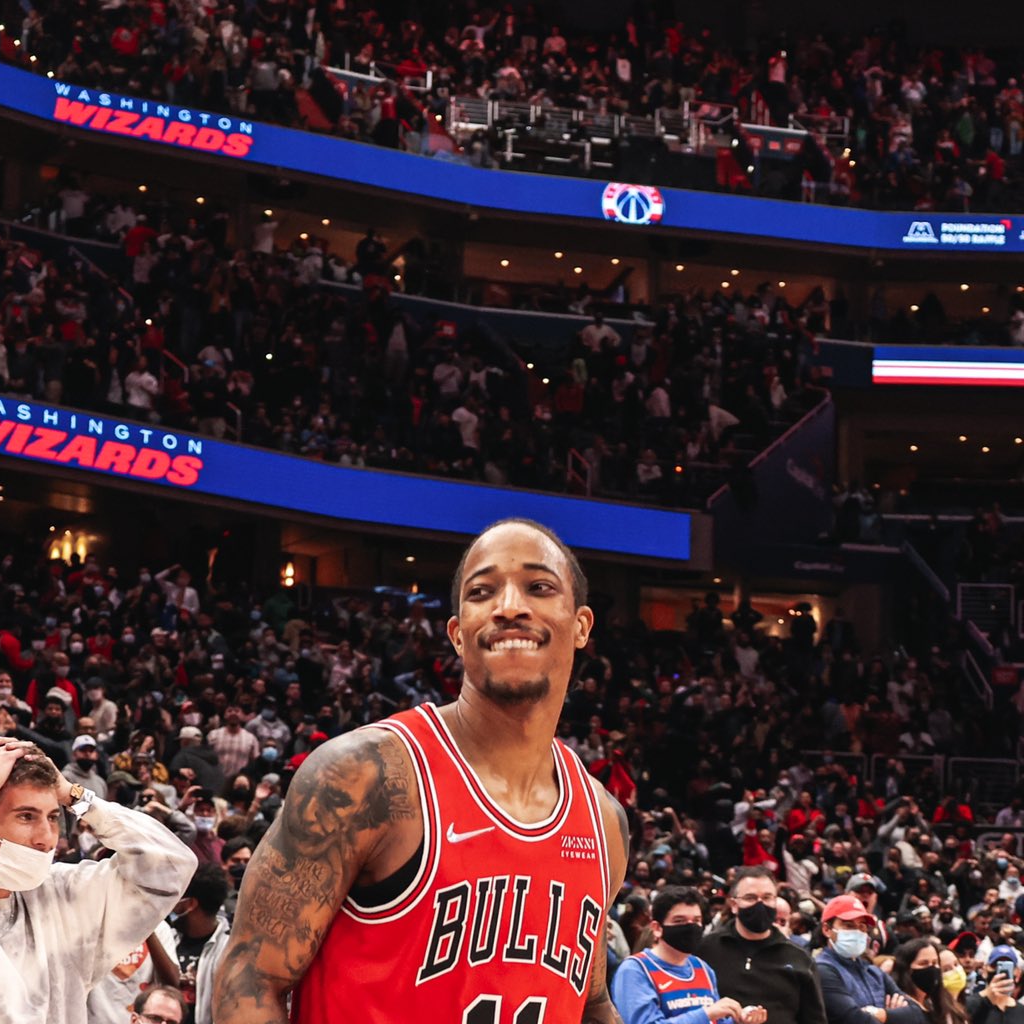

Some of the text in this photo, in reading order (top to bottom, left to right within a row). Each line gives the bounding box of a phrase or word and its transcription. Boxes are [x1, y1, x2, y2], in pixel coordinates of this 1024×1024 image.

[53, 97, 253, 157] WIZARDS
[55, 82, 253, 134] WASHINGTON
[561, 835, 595, 850] ZENNI
[561, 850, 596, 860] EYEWEAR
[415, 874, 603, 998] BULLS
